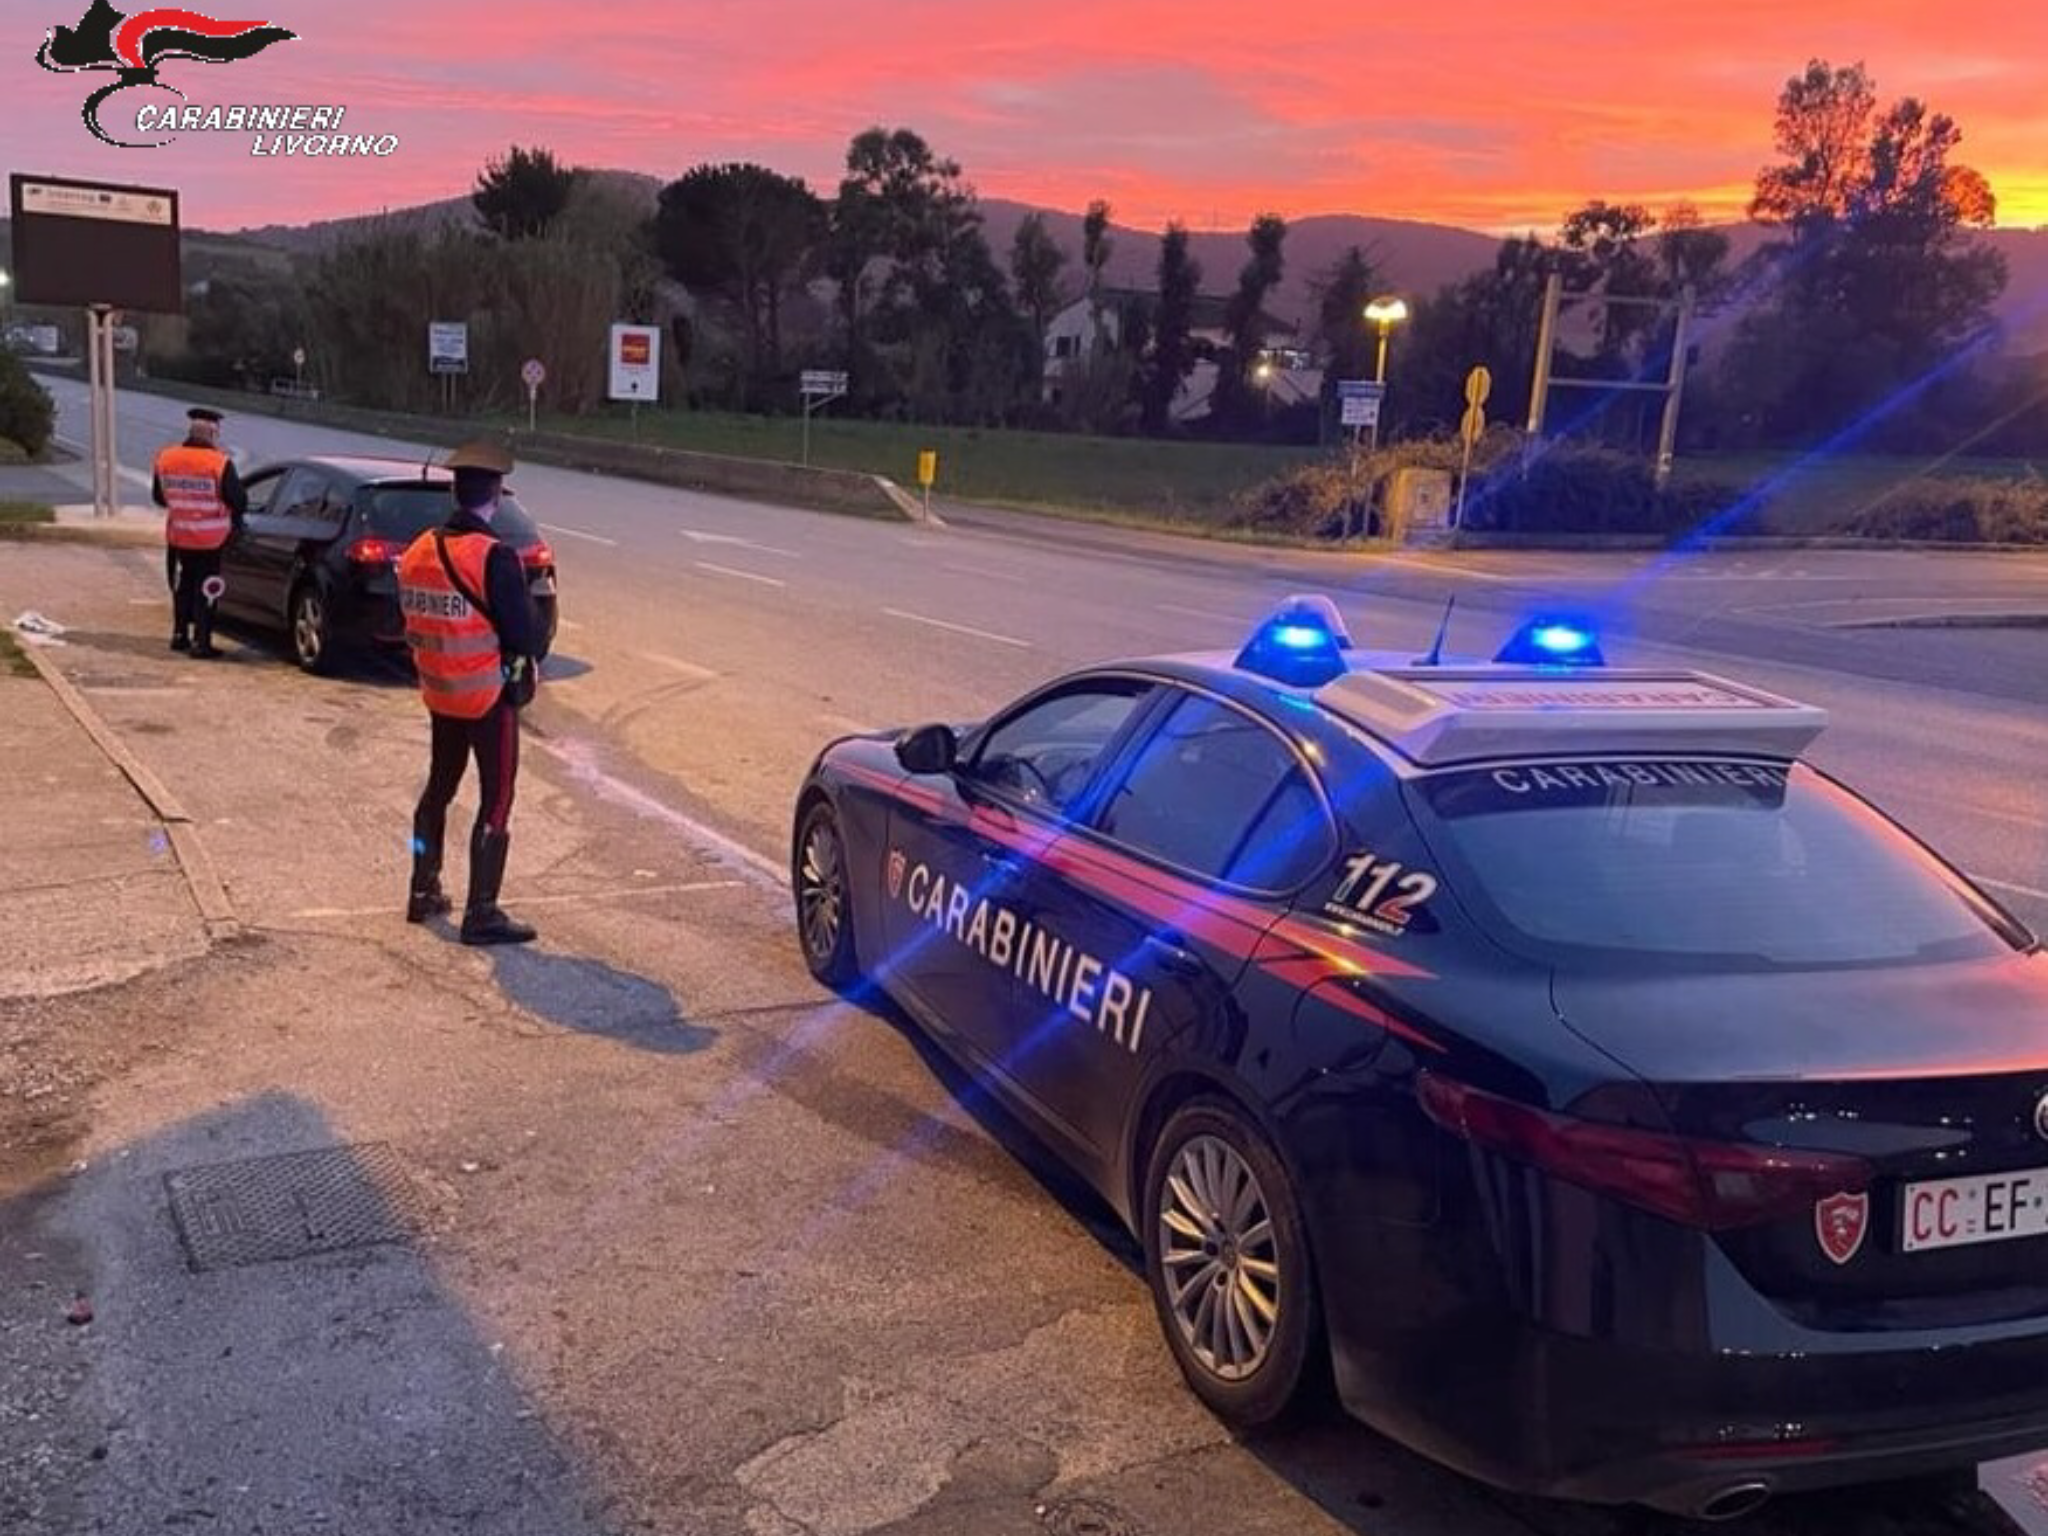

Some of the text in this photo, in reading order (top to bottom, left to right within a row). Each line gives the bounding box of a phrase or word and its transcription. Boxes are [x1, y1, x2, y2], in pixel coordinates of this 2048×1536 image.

[1332, 853, 1438, 925] 112
[907, 863, 1152, 1053] CARABINIERI
[1913, 1178, 2031, 1242] CC EF
